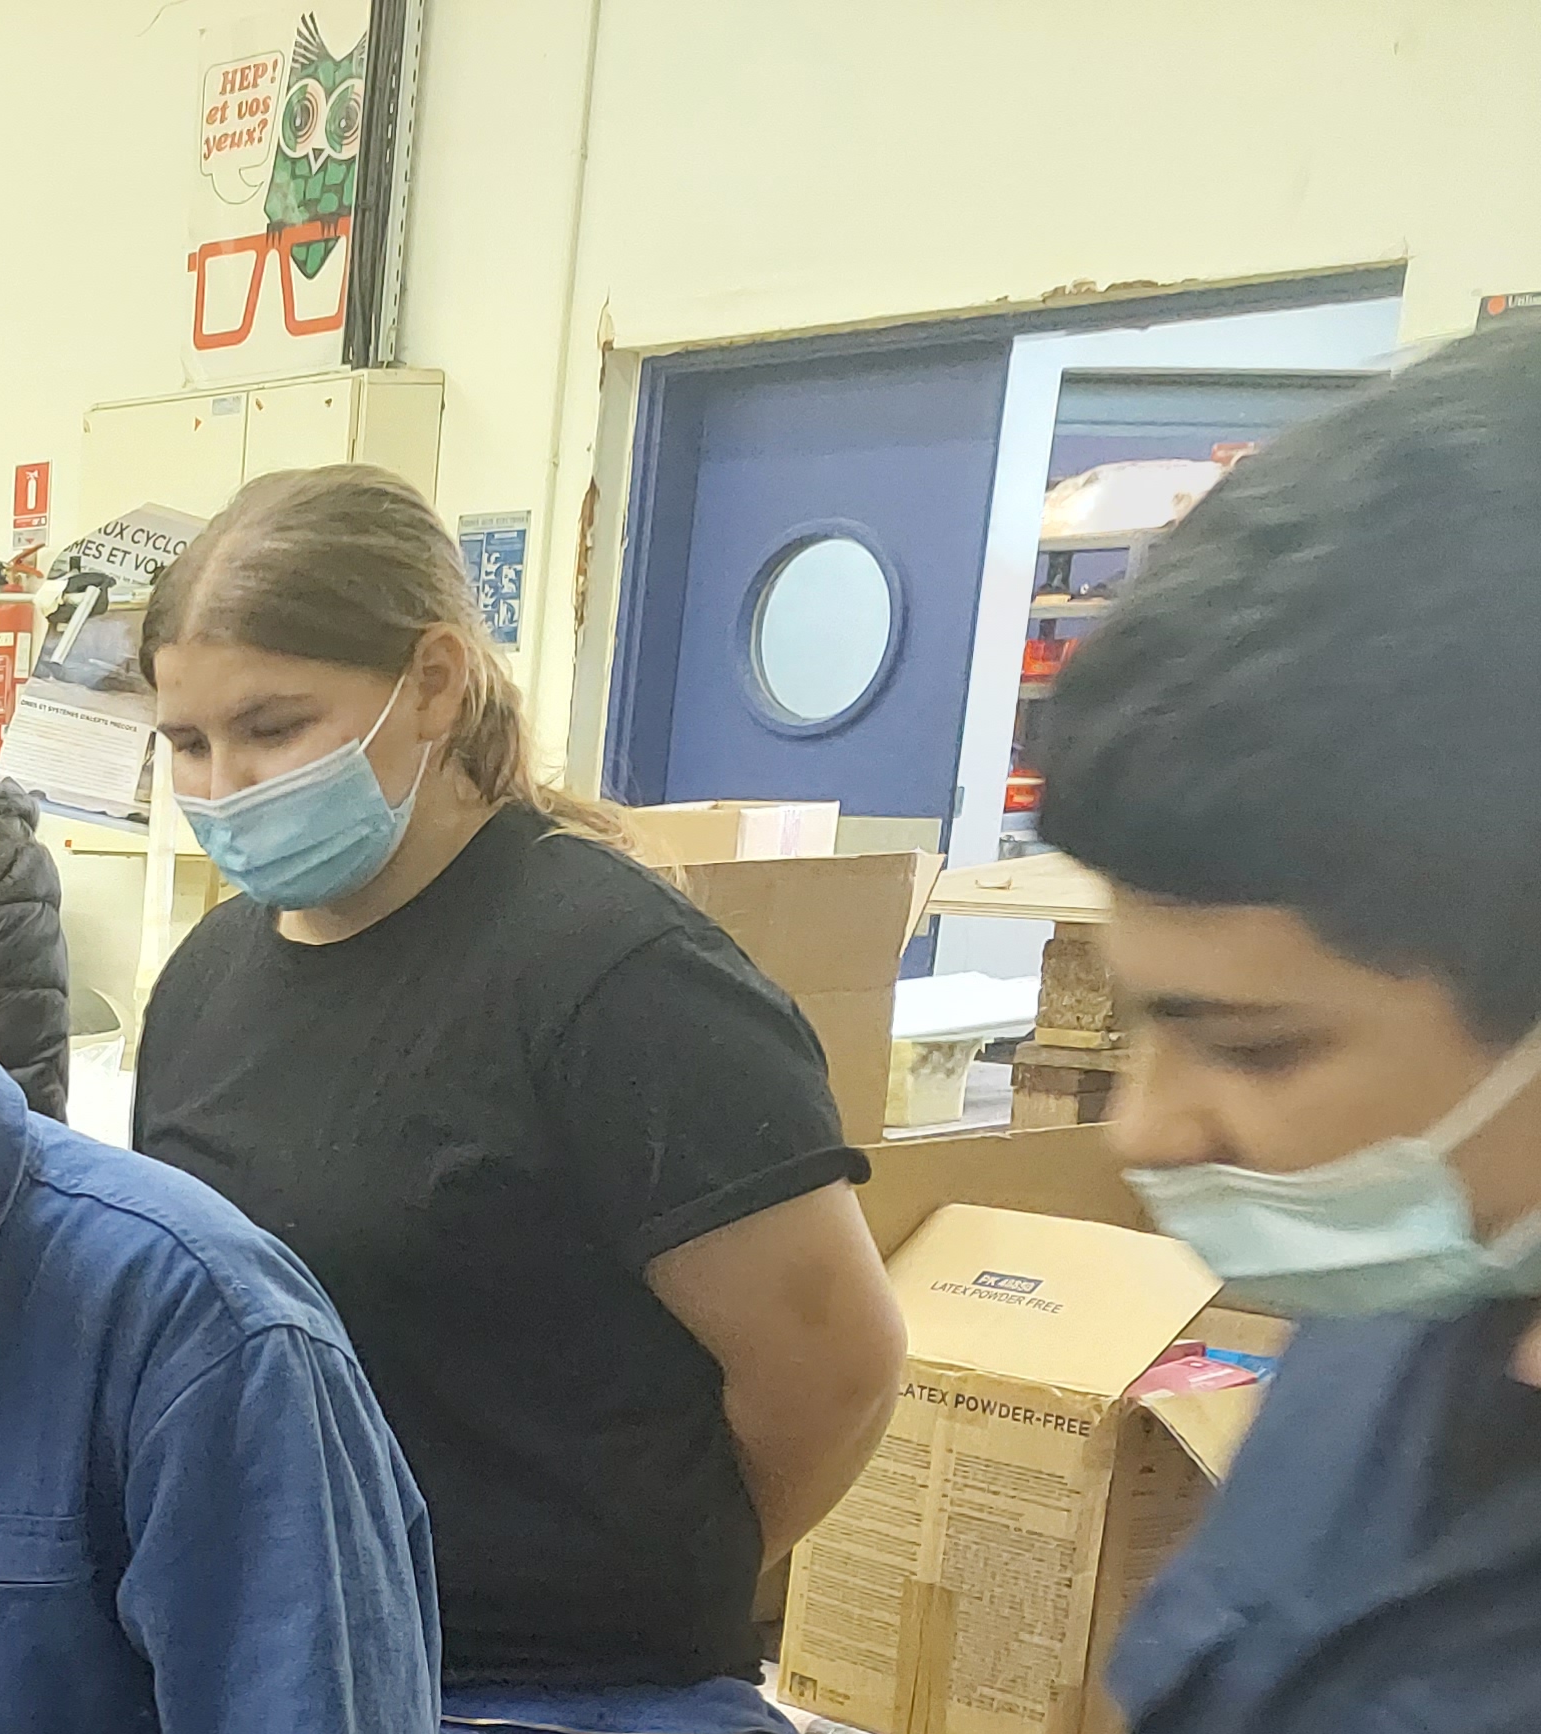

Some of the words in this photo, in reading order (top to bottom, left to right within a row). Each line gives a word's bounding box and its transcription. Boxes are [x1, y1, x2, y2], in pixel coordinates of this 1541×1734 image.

[206, 100, 229, 125] et
[237, 95, 271, 120] vos
[203, 118, 268, 161] yeux?
[62, 538, 105, 560] MES
[107, 547, 131, 567] ET
[134, 553, 166, 575] VO
[930, 1281, 971, 1296] LATEX
[969, 1288, 1025, 1305] POWDER
[1025, 1297, 1064, 1314] FREE
[954, 1393, 1092, 1437] POWDER-FREE
